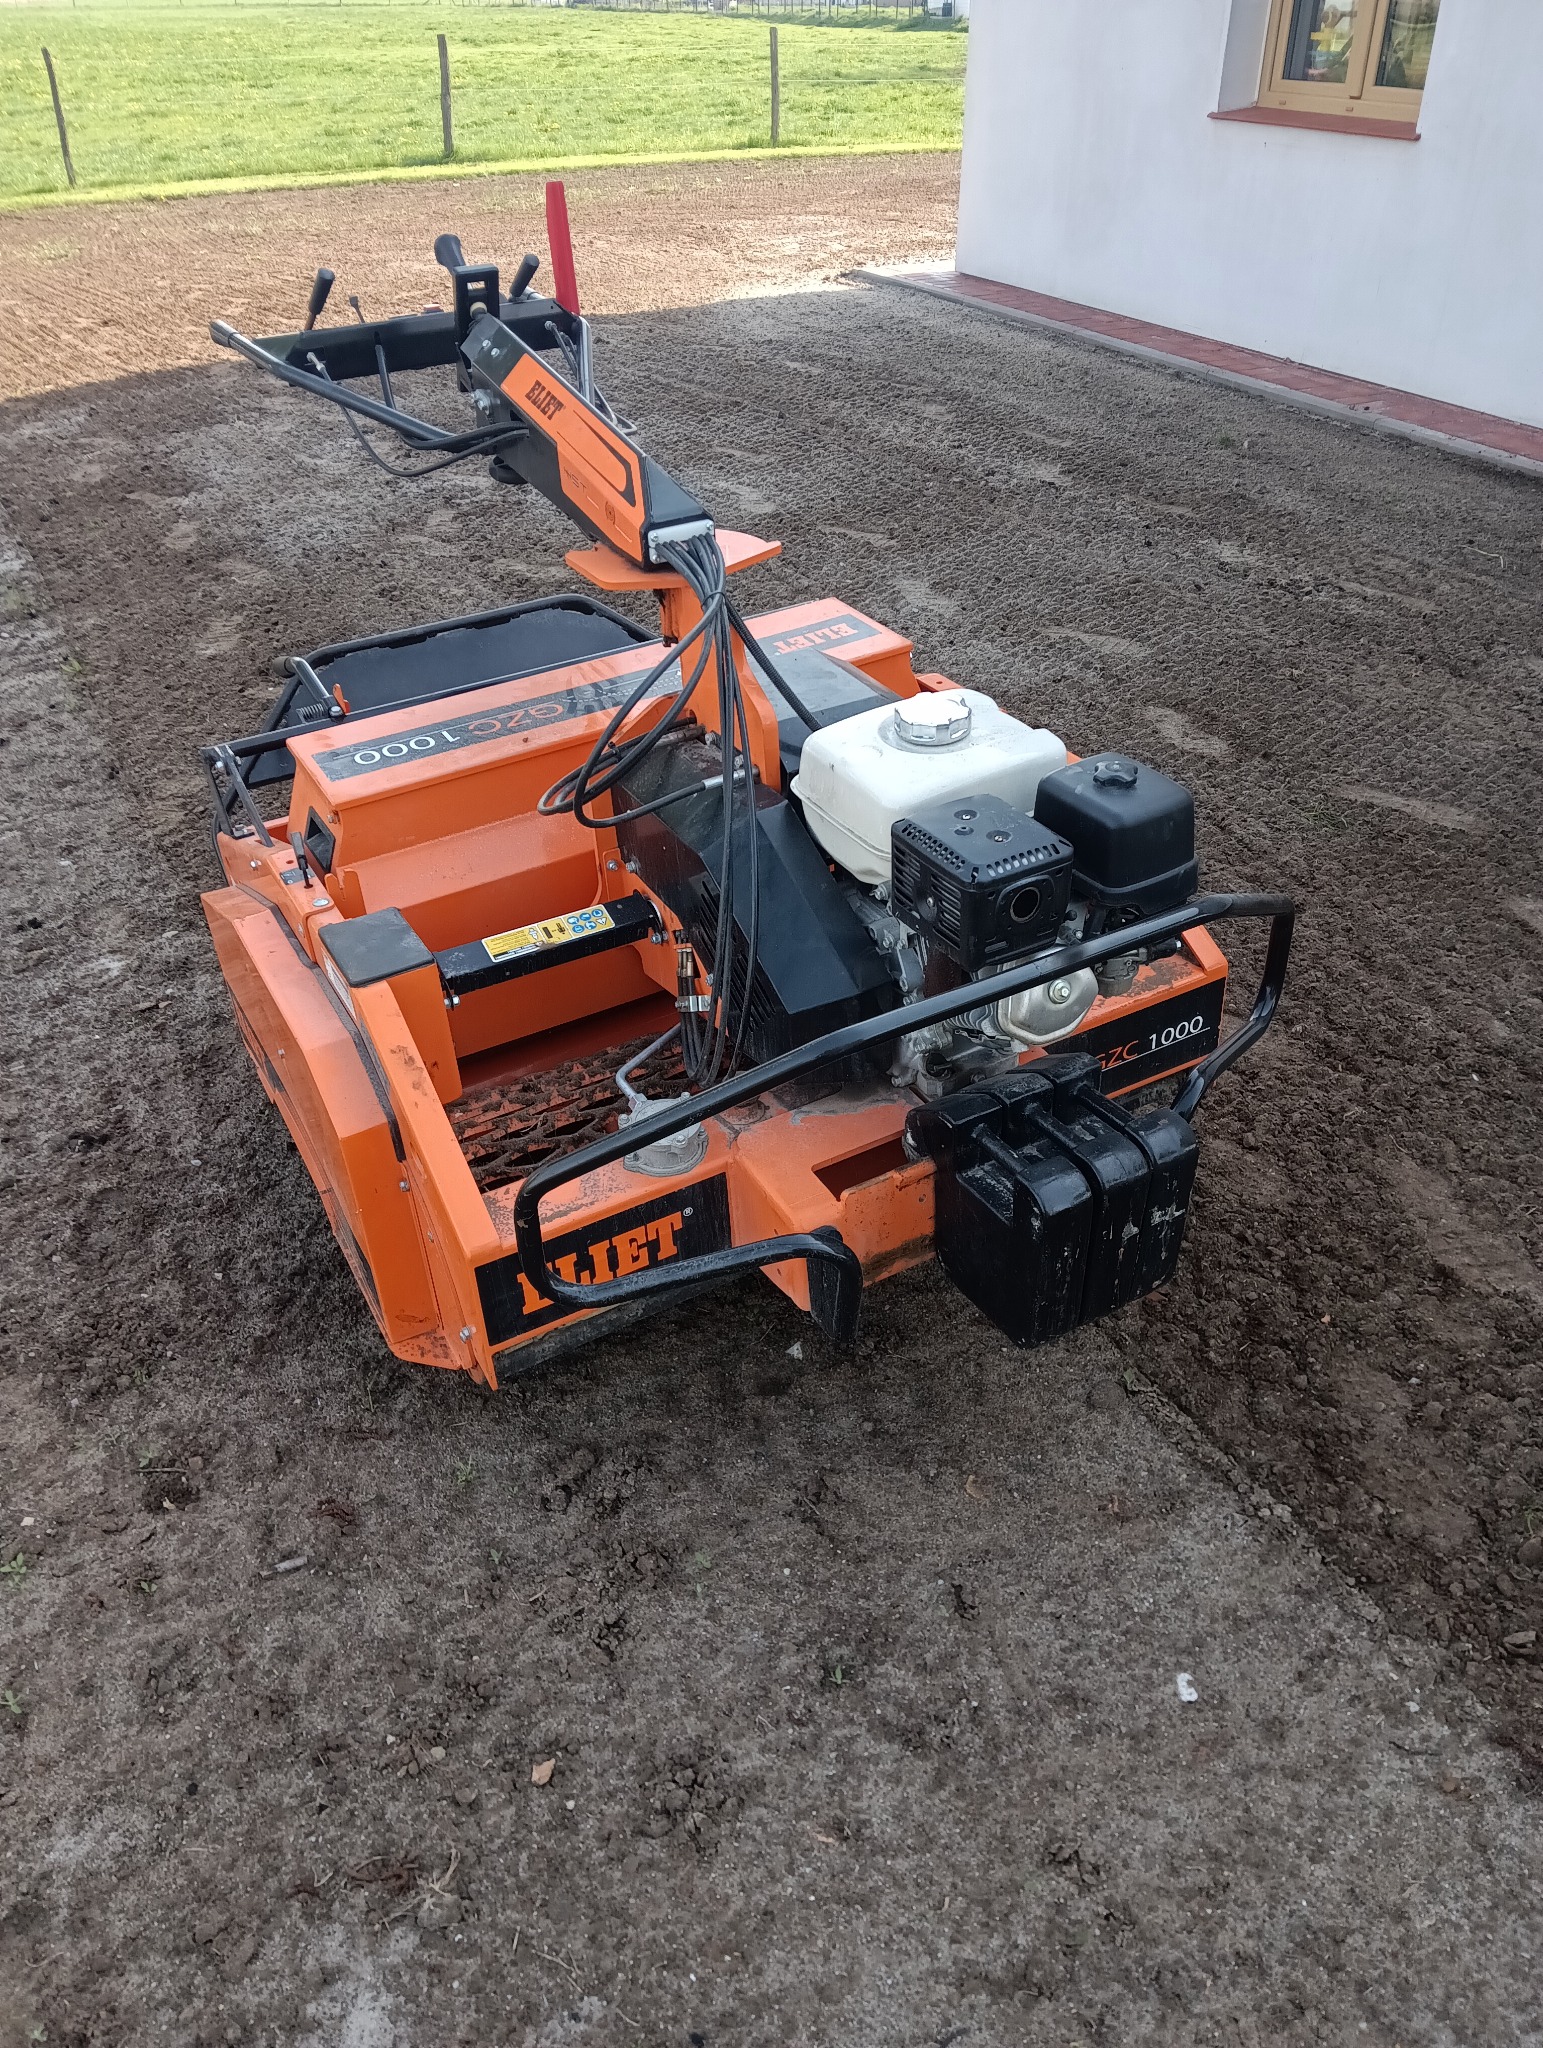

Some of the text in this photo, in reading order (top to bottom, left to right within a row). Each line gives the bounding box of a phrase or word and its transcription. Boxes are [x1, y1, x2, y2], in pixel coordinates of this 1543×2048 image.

[525, 379, 565, 420] ELIET
[773, 622, 859, 654] ELIET
[353, 703, 564, 765] GZC 1000
[1149, 1015, 1204, 1050] 1000
